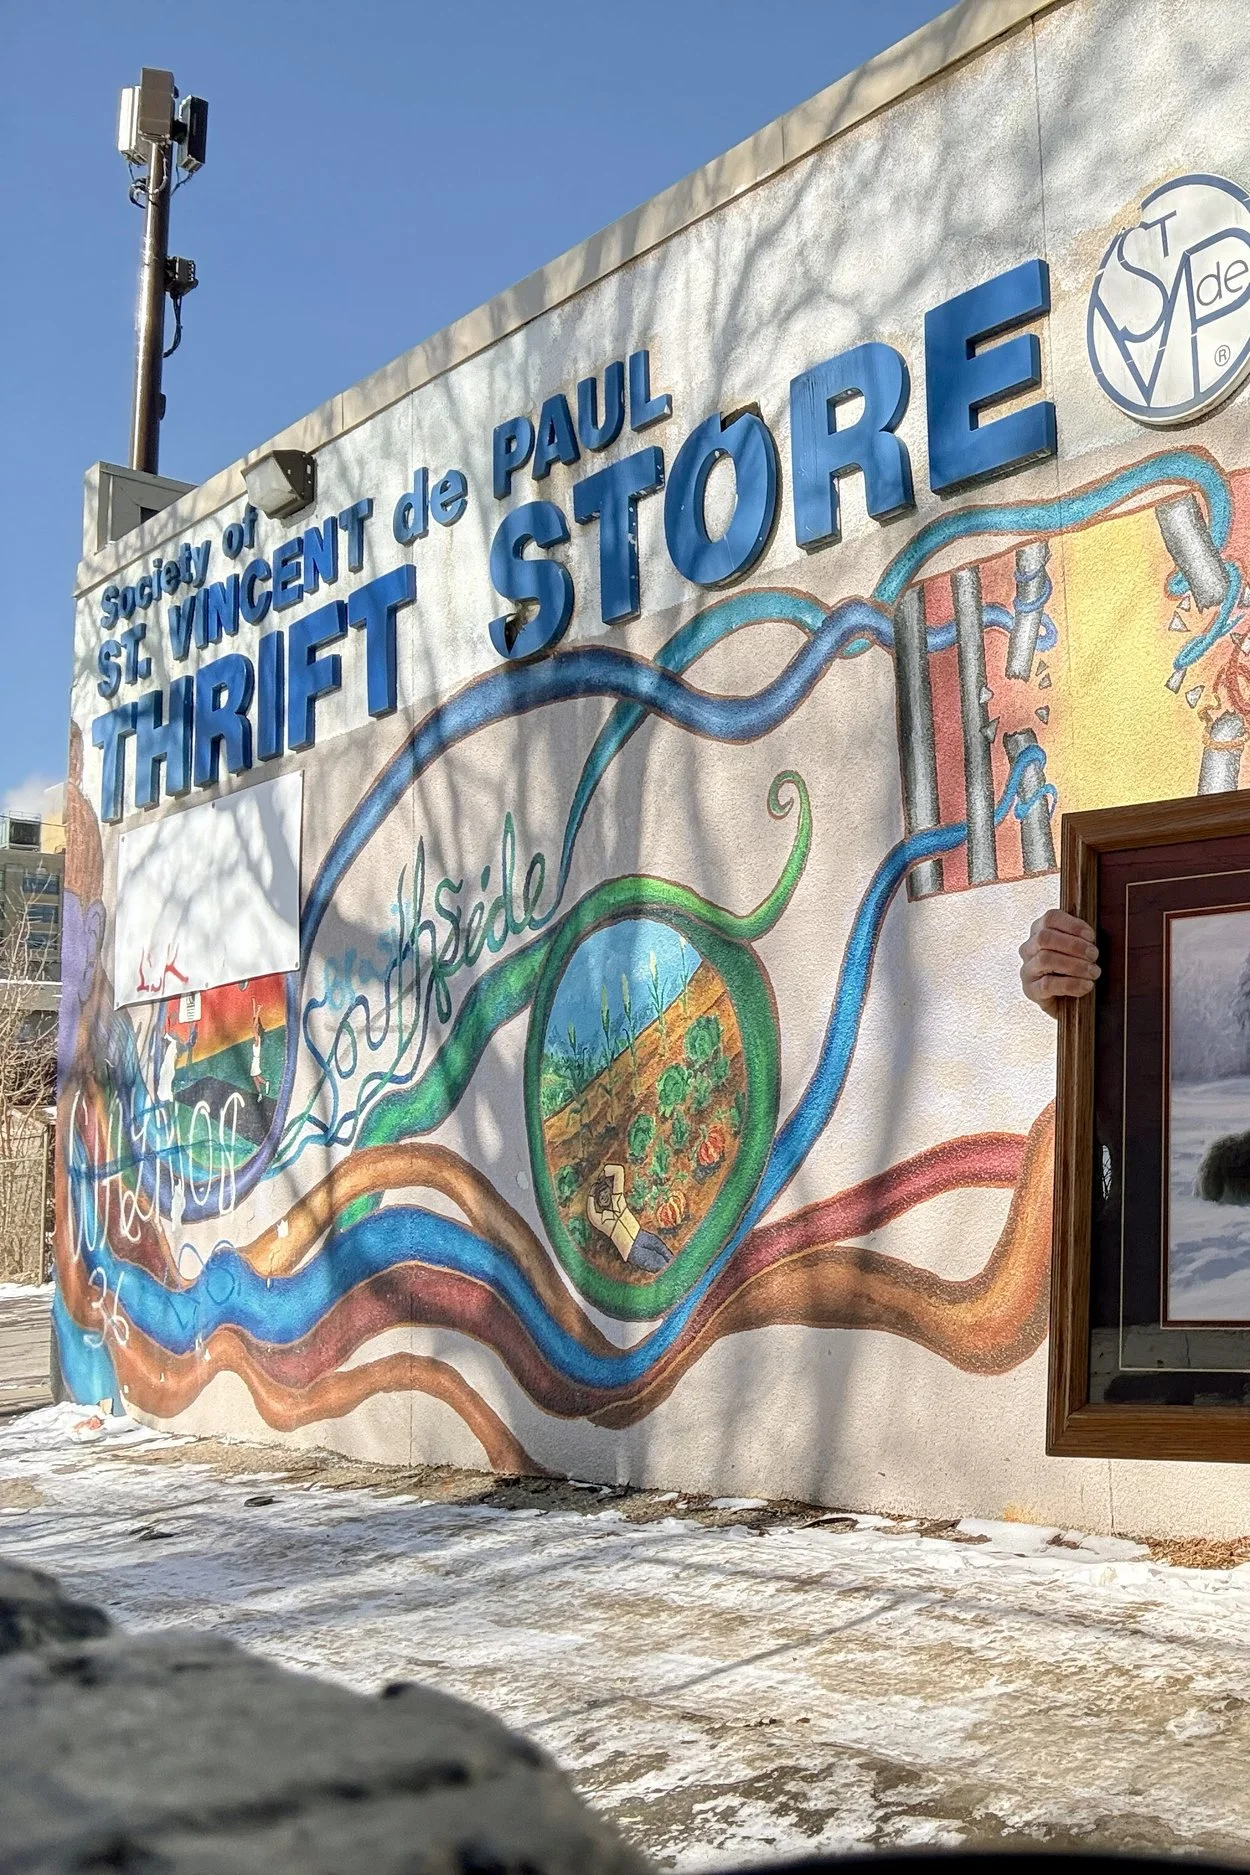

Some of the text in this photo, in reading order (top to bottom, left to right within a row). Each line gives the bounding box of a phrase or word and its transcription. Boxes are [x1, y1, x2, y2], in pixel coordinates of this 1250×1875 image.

[92, 258, 1058, 825] THRIFT STORE
[97, 349, 673, 699] ST. VINCENT de PAUL
[101, 502, 258, 630] Society of
